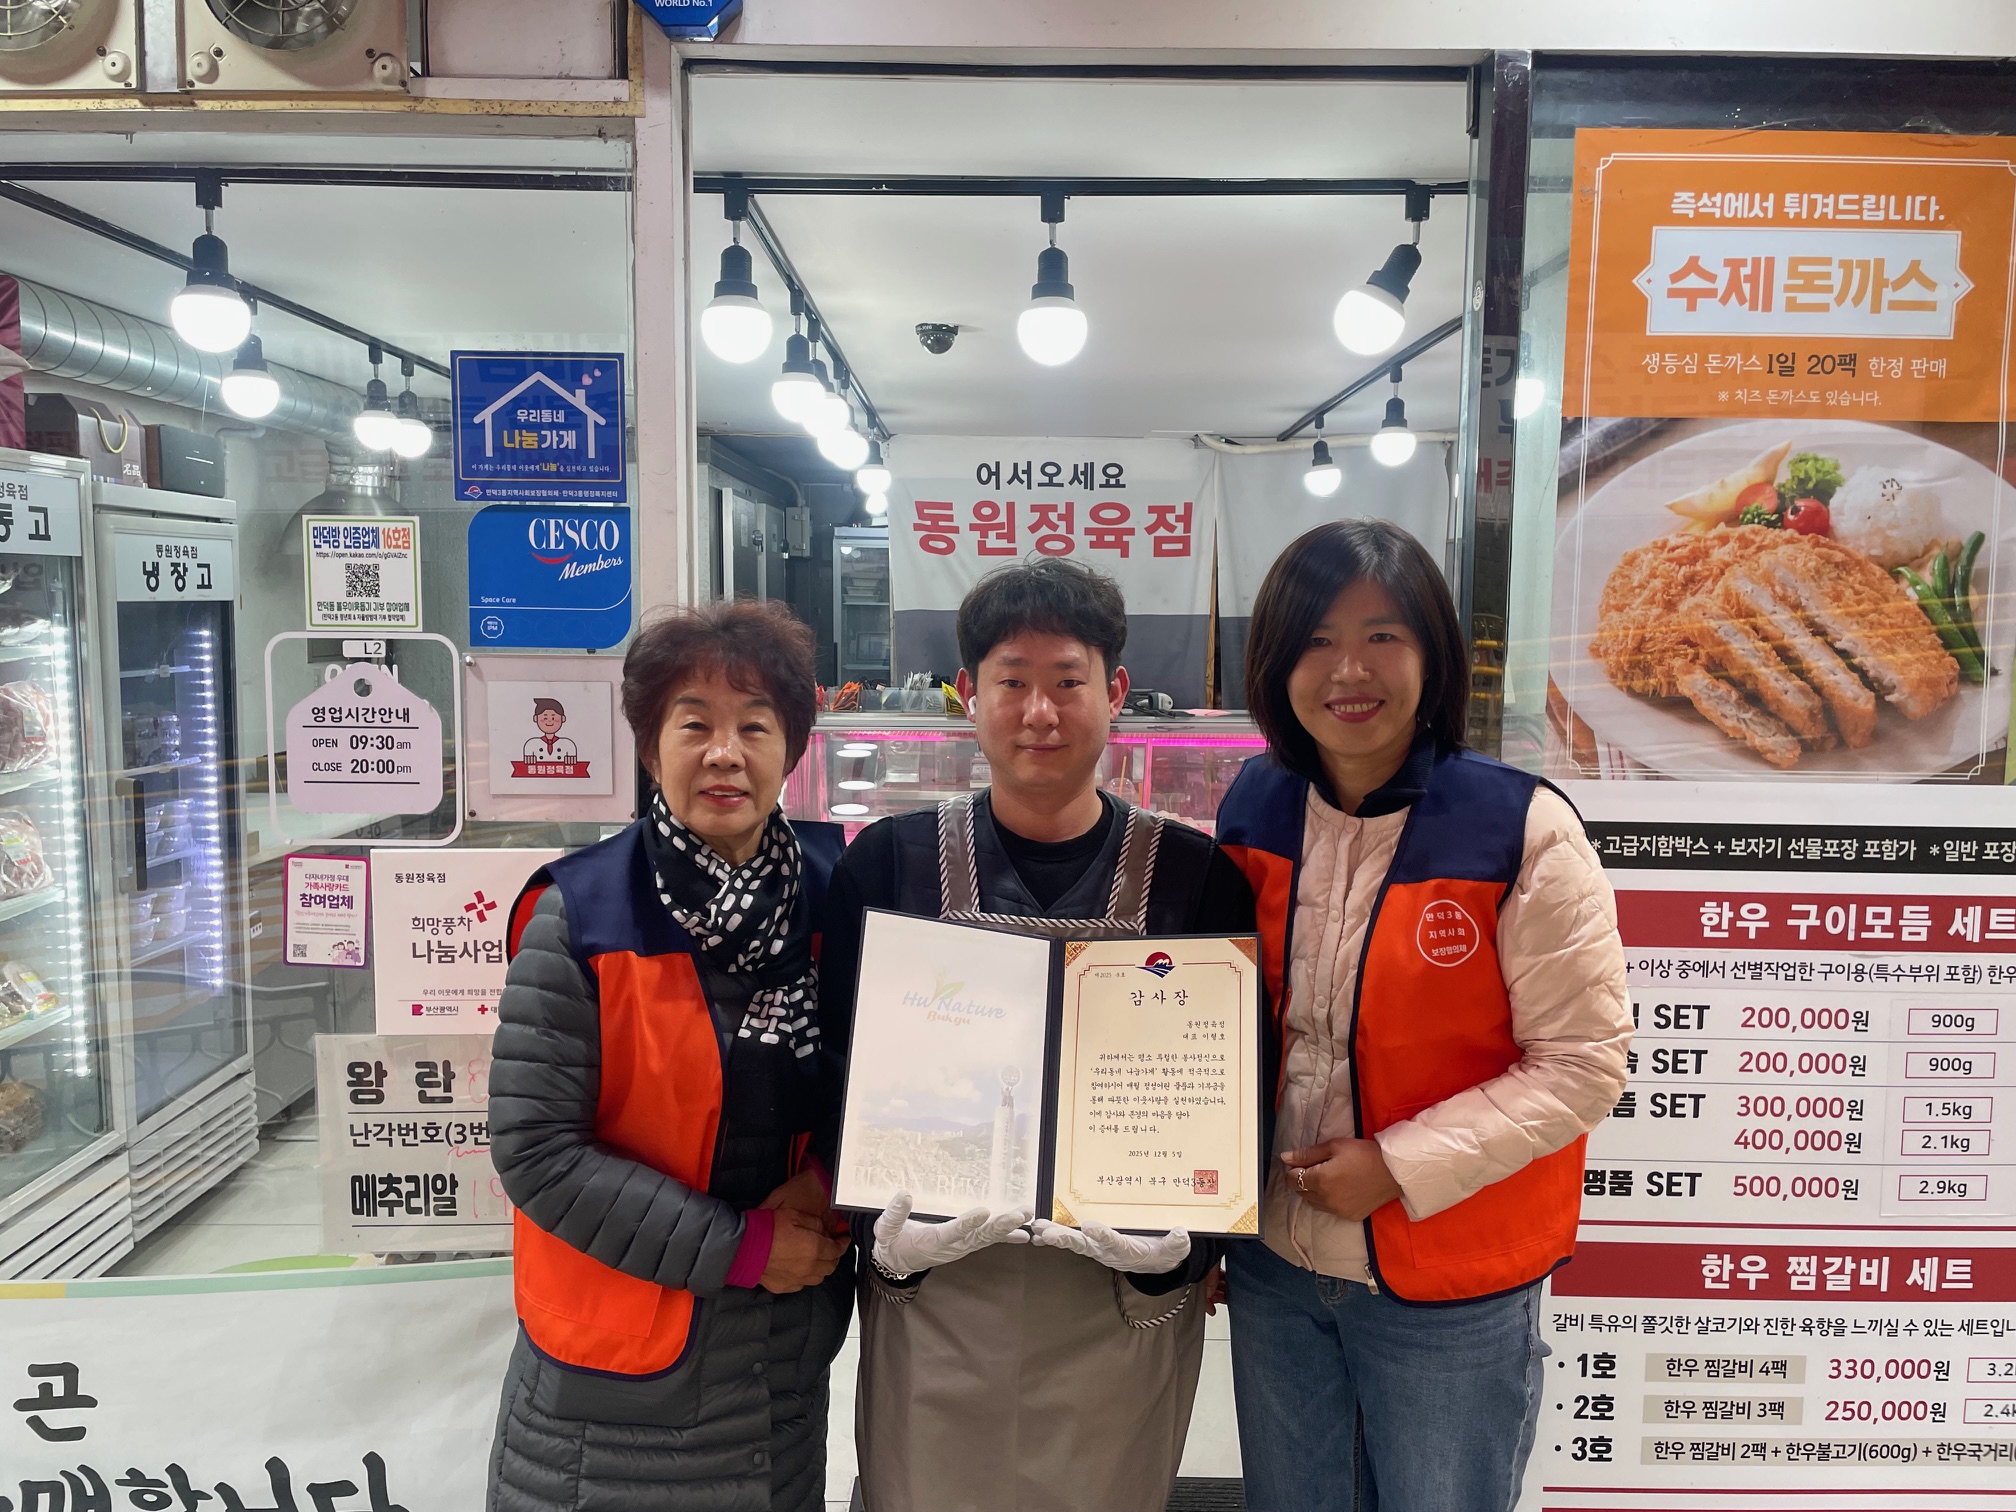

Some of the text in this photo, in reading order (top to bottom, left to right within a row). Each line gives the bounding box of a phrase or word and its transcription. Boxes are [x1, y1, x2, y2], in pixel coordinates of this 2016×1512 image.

[1670, 191, 1945, 222] 즉석에서 튀겨드립니다.
[1666, 255, 1938, 315] 수제 돈까스
[1641, 352, 1947, 379] 생등심 돈까스 1일 20팩 한정 판매
[1735, 388, 1882, 407] 치즈 돈까스도 있습니다.
[516, 409, 565, 423] 우리동네
[976, 461, 1127, 491] 어서오세요
[312, 526, 411, 550] 만덕방 인증업체 16호점
[528, 518, 620, 551] CESCO
[912, 500, 1193, 558] 동원정육점
[155, 544, 198, 559] 동원정육점
[558, 554, 624, 581] Members
[480, 596, 517, 604] Space Care
[364, 642, 382, 655] L2
[311, 706, 411, 724] 영업시간안내
[312, 738, 338, 748] OPEN
[311, 762, 342, 772] CLOSE
[527, 765, 574, 775] 동원정육점
[1729, 837, 1782, 859] 보자기
[1787, 838, 1858, 861] 선물포장
[1862, 839, 1917, 862] 포함가
[1982, 841, 2016, 863] 포장
[304, 873, 350, 883] 다자녀가정 우대
[304, 882, 350, 892] 가족사랑카드
[394, 872, 446, 884] 동원정육점
[299, 893, 354, 910] 참여업체
[411, 916, 473, 936] 희망풍차
[1699, 900, 2016, 943] 한우 구이모듬 세트
[1639, 958, 2016, 985] 이상 중에서 선별작업한 구이용(특수부위 포함) 한우
[422, 989, 435, 997] 우리
[438, 988, 465, 997] 이웃에게
[466, 988, 487, 997] 희망을
[425, 1006, 459, 1014] 부산광역시
[937, 996, 1007, 1019] Nature
[1653, 1004, 1711, 1031] SET
[1931, 1013, 1976, 1032] 900g
[1651, 1048, 1708, 1075] SET
[1928, 1057, 1973, 1076] 900g
[1649, 1092, 1706, 1119] SET
[1925, 1102, 1973, 1120] 1.5kg
[1128, 1150, 1183, 1159] 2025년 12월 5일
[1921, 1135, 1970, 1153] 2.1kg
[1097, 1175, 1143, 1186] 부산광역시
[1148, 1176, 1167, 1186] 북구
[1583, 1169, 1633, 1197] 명품
[1646, 1171, 1702, 1198] SET
[1918, 1180, 1968, 1198] 2.9kg
[351, 1172, 459, 1218] 메추리알
[1700, 1253, 1974, 1293] 한우 찜갈비 세트
[1552, 1313, 1584, 1333] 갈비
[1588, 1314, 1638, 1334] 특유의
[1641, 1315, 1691, 1335] 쫄깃한
[1694, 1315, 1761, 1336] 살코기와
[1763, 1316, 1796, 1336] 진한
[1799, 1316, 1848, 1337] 육향을
[1850, 1317, 1899, 1337] 느끼실
[1902, 1319, 1918, 1337] 수
[1923, 1317, 1954, 1338] 있는
[1576, 1352, 1617, 1380] 1호
[1665, 1357, 1699, 1378] 한우
[1703, 1357, 1754, 1379] 찜갈비
[1758, 1359, 1788, 1379] 4팩
[1986, 1362, 2016, 1377] 3.2
[12, 1361, 98, 1443] 곤
[1573, 1394, 1615, 1421] 2호
[1663, 1399, 1697, 1420] 한우
[1701, 1399, 1752, 1420] 찜갈비
[1756, 1400, 1785, 1420] 3팩
[1571, 1436, 1613, 1463] 3호
[1654, 1441, 1686, 1461] 한우
[1688, 1441, 1737, 1462] 찜갈비
[1740, 1442, 1768, 1462] 2팩
[1785, 1441, 1918, 1464] 한우불고기(600g)
